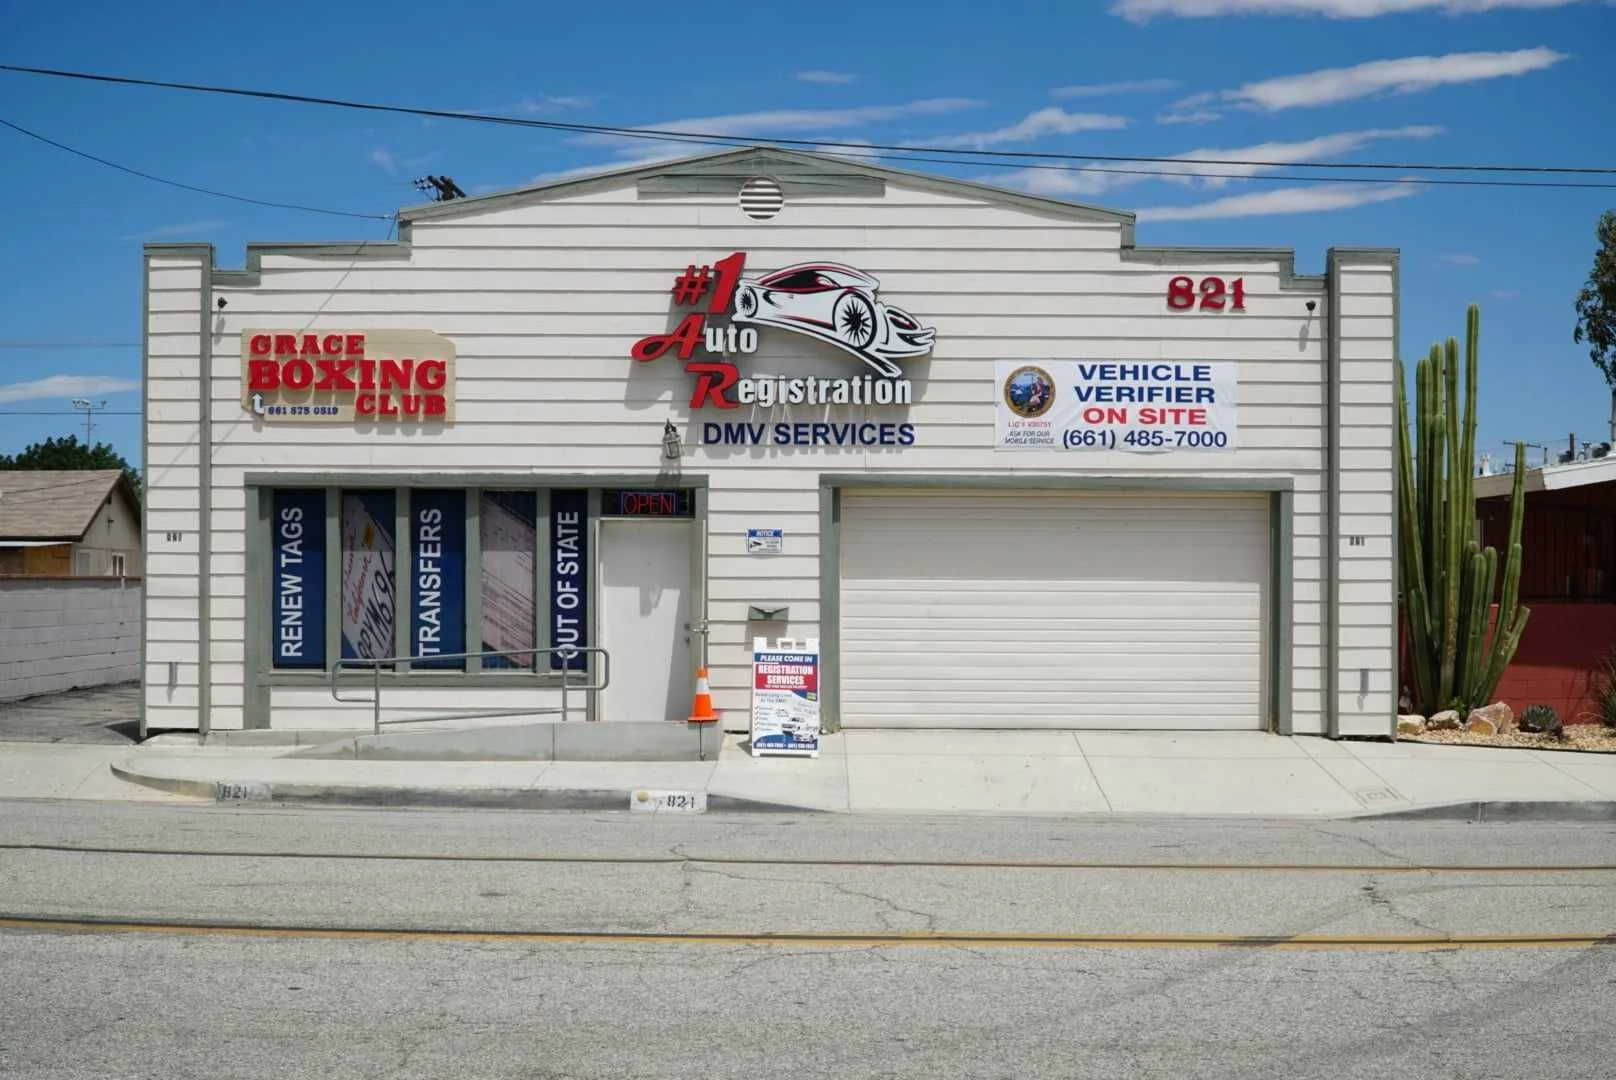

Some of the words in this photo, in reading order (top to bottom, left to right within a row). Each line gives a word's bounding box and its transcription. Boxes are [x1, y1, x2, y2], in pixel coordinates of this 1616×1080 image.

[671, 252, 747, 314] #1
[1167, 276, 1246, 310] 821
[250, 334, 365, 355] GRACE
[631, 312, 759, 362] Auto
[248, 359, 447, 390] BOXING
[1078, 364, 1212, 382] VEHICLE
[685, 362, 912, 409] Registration
[1074, 385, 1215, 403] VERIFIER
[355, 394, 446, 415] CLUB
[1083, 408, 1127, 424] ON
[1139, 408, 1207, 425] SITE
[703, 423, 766, 445] DMV
[773, 422, 915, 445] SERVICES
[1063, 429, 1116, 449] (661)
[1124, 430, 1228, 448] 485-7000
[624, 494, 672, 514] OPEN
[281, 507, 303, 568] TAGS
[556, 511, 579, 576] STATE
[418, 508, 442, 657] TRANSFERS
[556, 580, 579, 610] OF
[281, 574, 303, 657] RENEW
[556, 614, 579, 660] OUT
[758, 664, 814, 675] REGISTRATION
[784, 655, 804, 663] COME
[767, 675, 805, 685] SERVICES
[667, 795, 694, 808] 821
